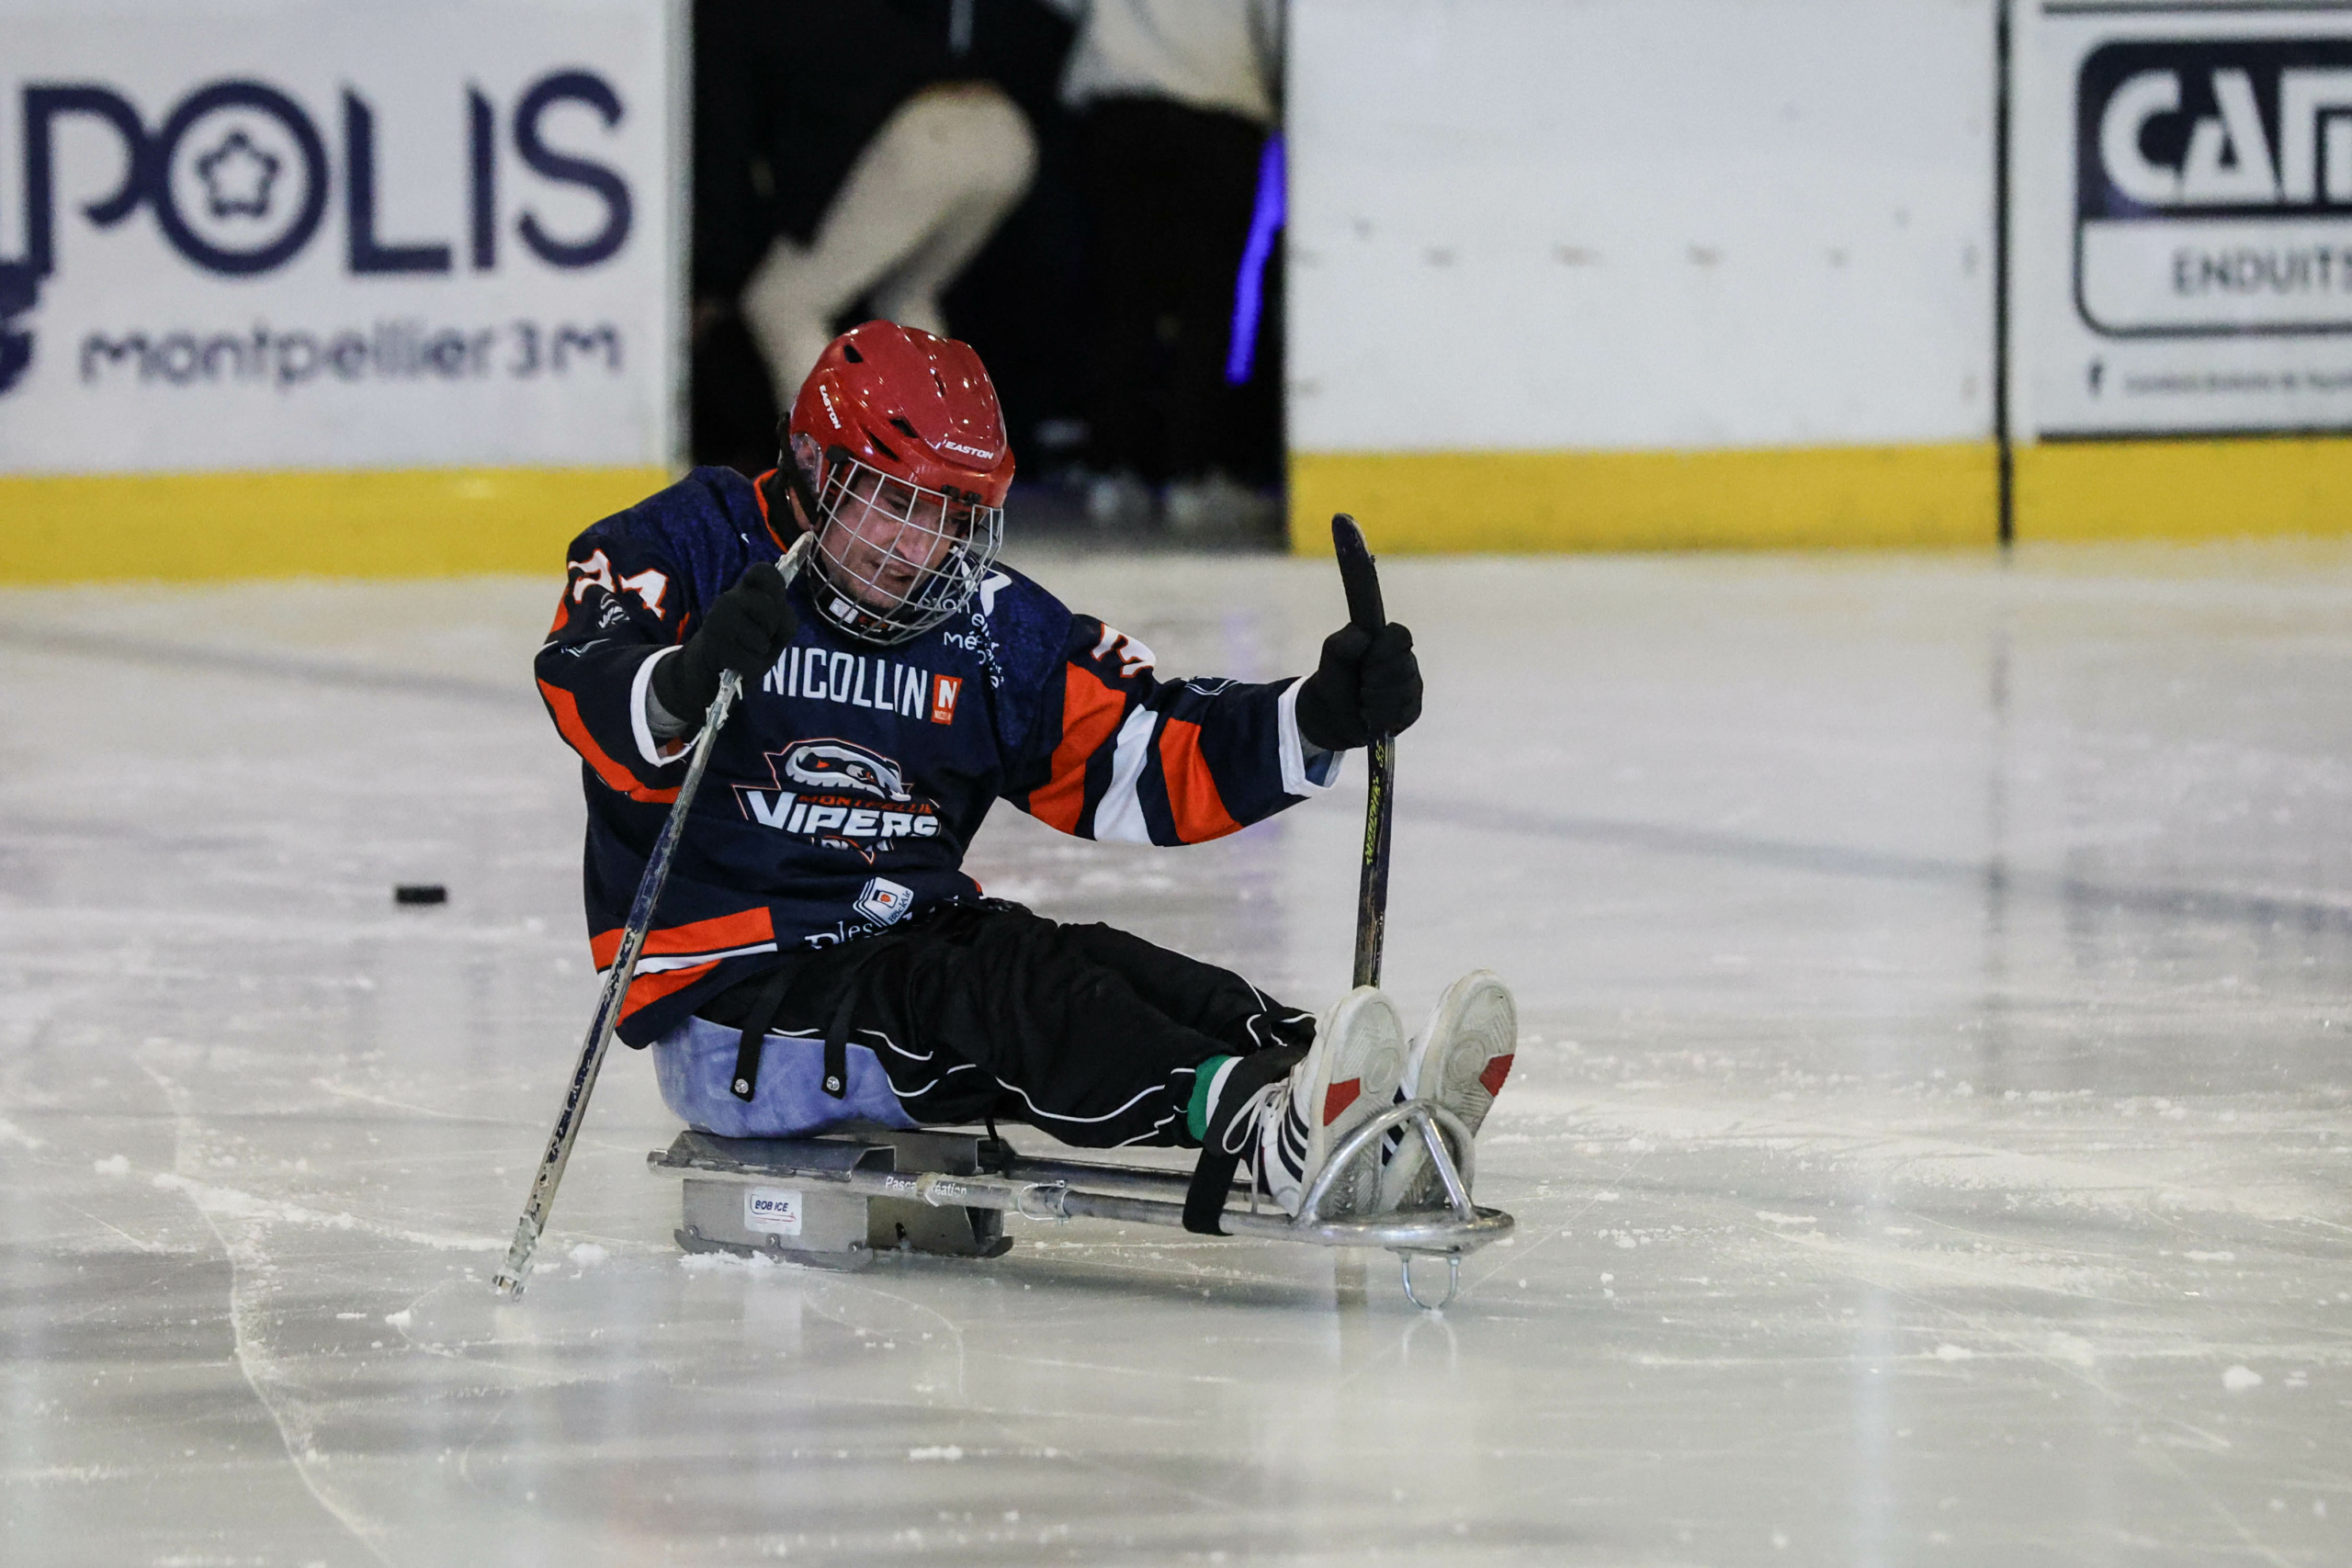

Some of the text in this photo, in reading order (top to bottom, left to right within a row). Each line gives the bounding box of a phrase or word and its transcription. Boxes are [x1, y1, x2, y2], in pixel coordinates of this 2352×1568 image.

[820, 385, 842, 429] EASTON
[944, 441, 994, 459] EASTON
[763, 647, 928, 720] NICOLLIN
[746, 790, 939, 838] VIPERS
[754, 1200, 789, 1213] BOB ICE
